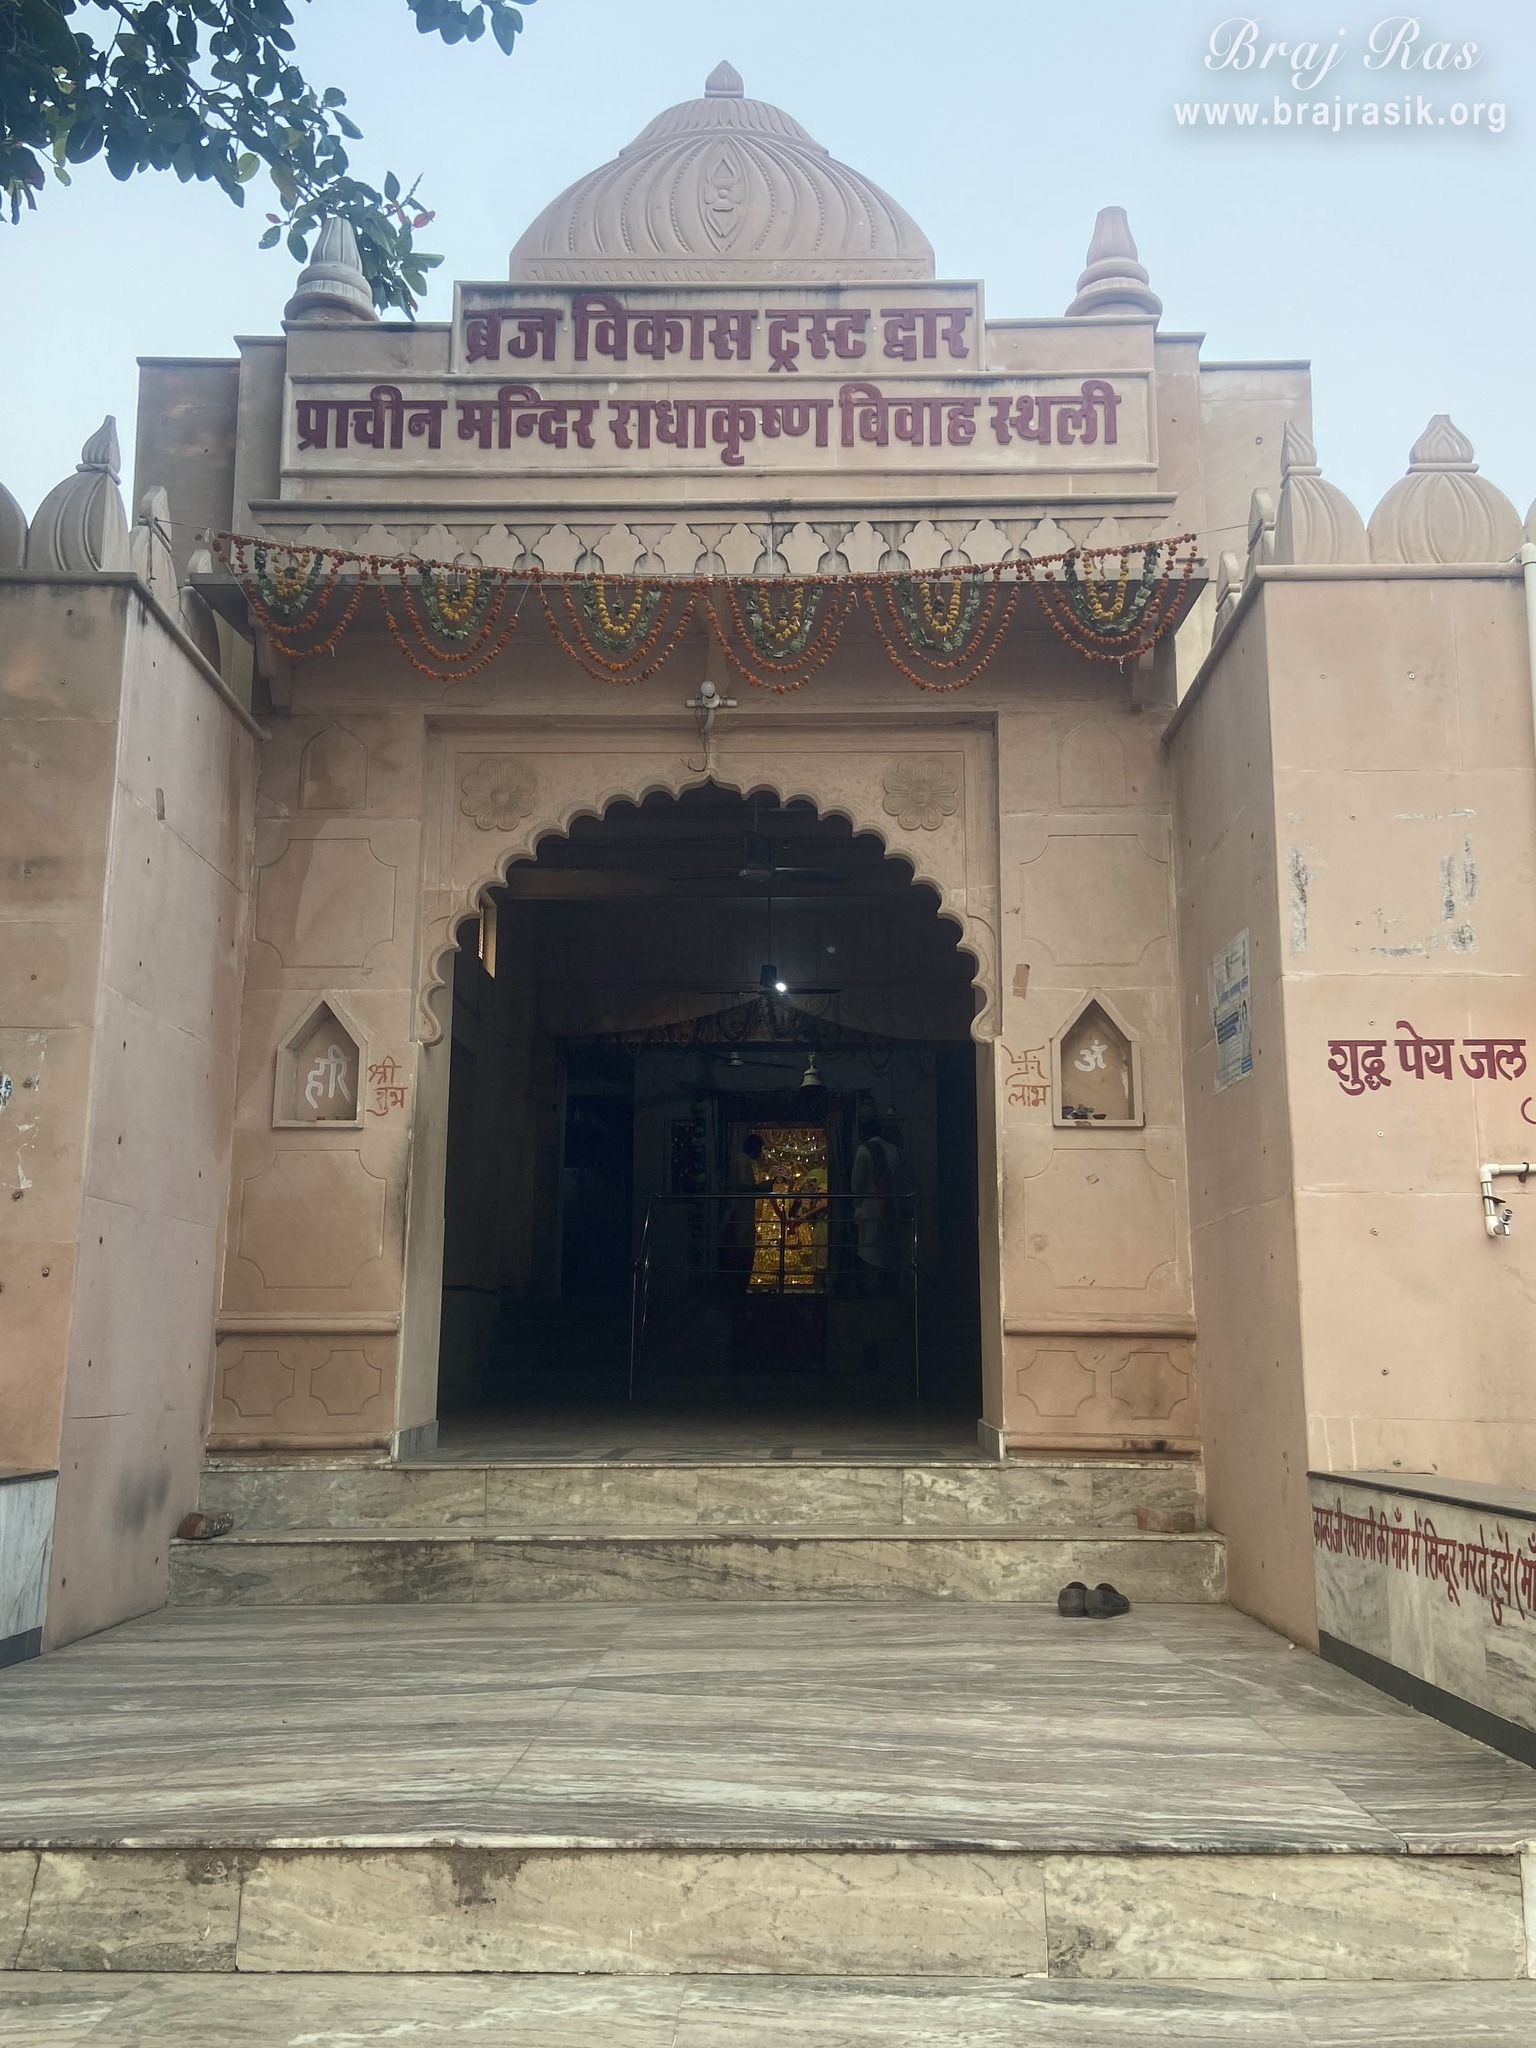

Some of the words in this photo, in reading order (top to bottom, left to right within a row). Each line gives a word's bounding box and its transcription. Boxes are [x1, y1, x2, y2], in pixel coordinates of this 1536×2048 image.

[464, 308, 564, 363] ब्रज
[572, 294, 758, 361] विकास
[766, 308, 871, 373] ट्रस्ट
[880, 307, 973, 362] द्वार
[296, 385, 448, 451] प्राचीन
[456, 385, 600, 450] मन्दिर
[839, 383, 981, 447] विवाह
[989, 379, 1122, 446] स्थली
[1394, 1020, 1455, 1081] पेय
[1459, 1039, 1527, 1081] जल
[366, 1086, 408, 1116] शुभ
[1008, 1084, 1051, 1107] लाभ
[1377, 1511, 1389, 1566] की
[1411, 1510, 1422, 1577] में
[1458, 1524, 1489, 1598] भरते
